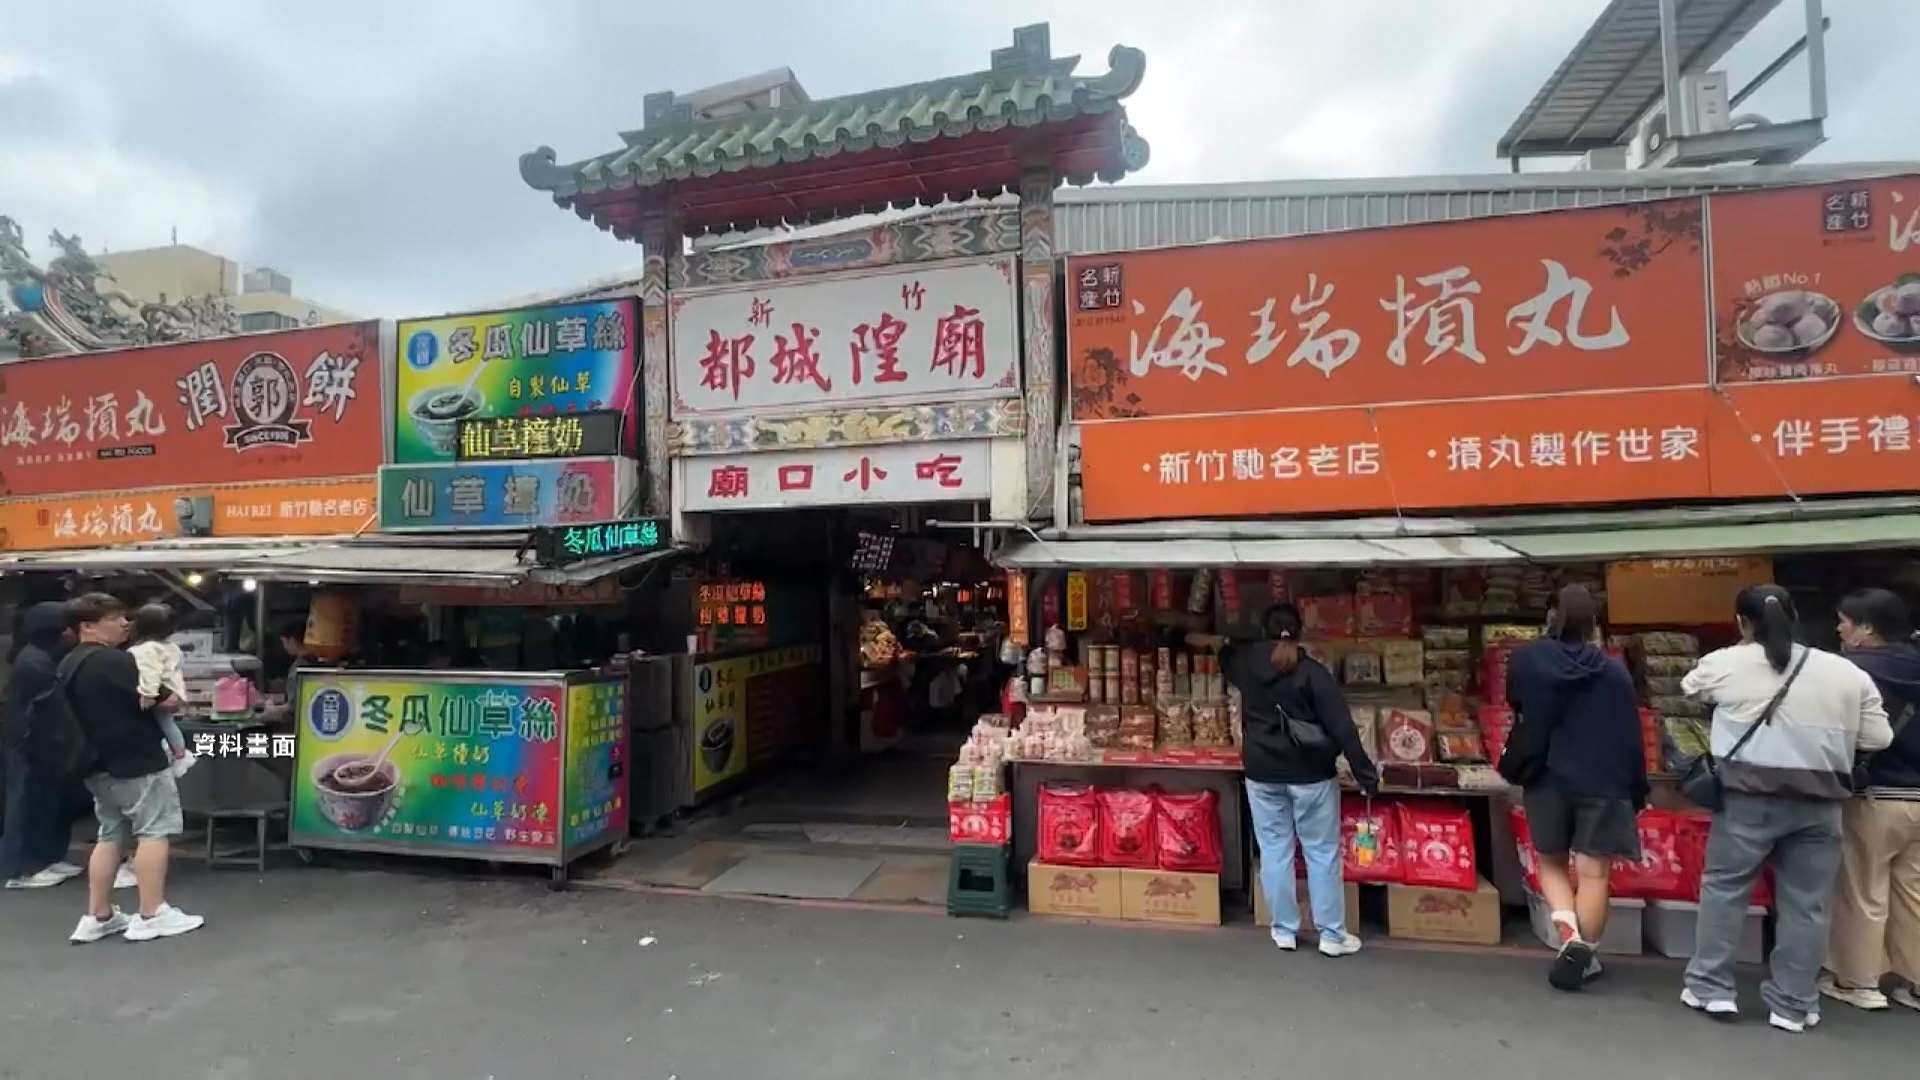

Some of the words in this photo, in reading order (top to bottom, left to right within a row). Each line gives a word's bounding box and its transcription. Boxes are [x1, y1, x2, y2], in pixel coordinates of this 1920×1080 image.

[448, 311, 626, 364] 冬瓜仙草絲
[1128, 259, 1631, 380] 海瑞摃丸
[699, 304, 986, 400] 都城隍廟
[249, 376, 281, 419] 郭
[461, 417, 583, 456] 仙草撞奶
[1447, 425, 1700, 471] 摃丸製作世家
[1772, 414, 1920, 456] 伴手禮
[708, 454, 963, 498] 廟口小吃
[1158, 443, 1381, 485] 新竹馳名老店
[226, 504, 248, 517] HAI
[360, 688, 559, 743] 冬瓜仙草絲
